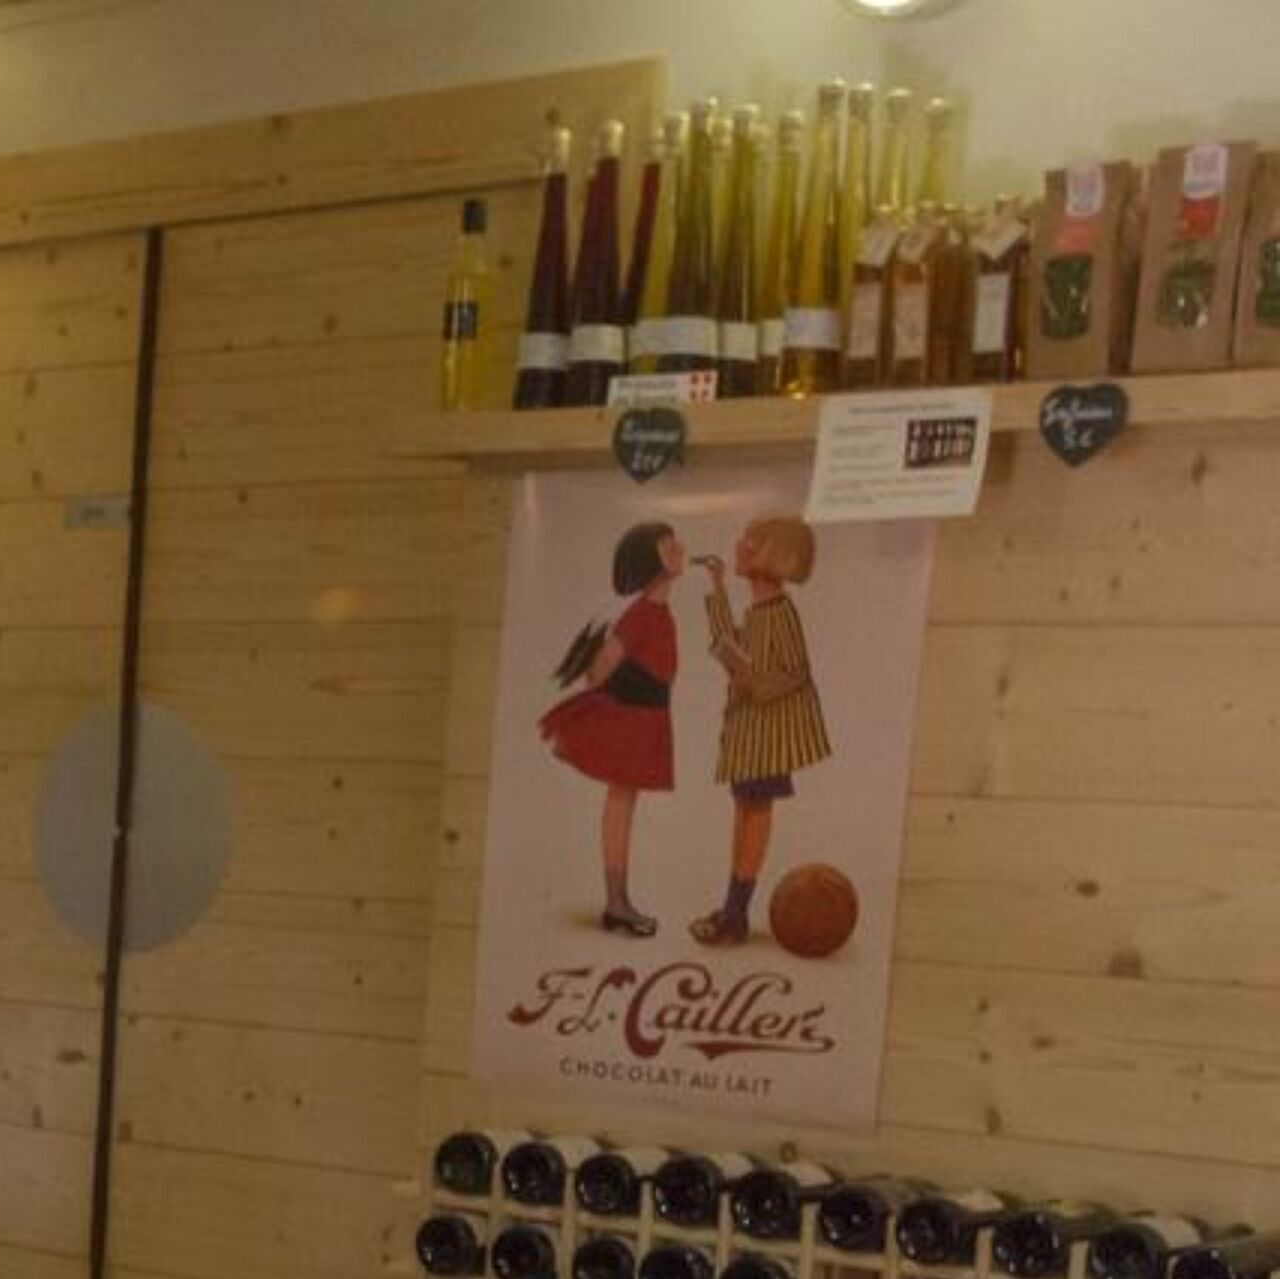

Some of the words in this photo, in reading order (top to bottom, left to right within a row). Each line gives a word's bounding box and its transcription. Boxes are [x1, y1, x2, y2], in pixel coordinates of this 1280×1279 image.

[559, 1056, 682, 1089] CHOCOLAT
[689, 1073, 718, 1093] AU
[725, 1075, 774, 1097] LAIT
